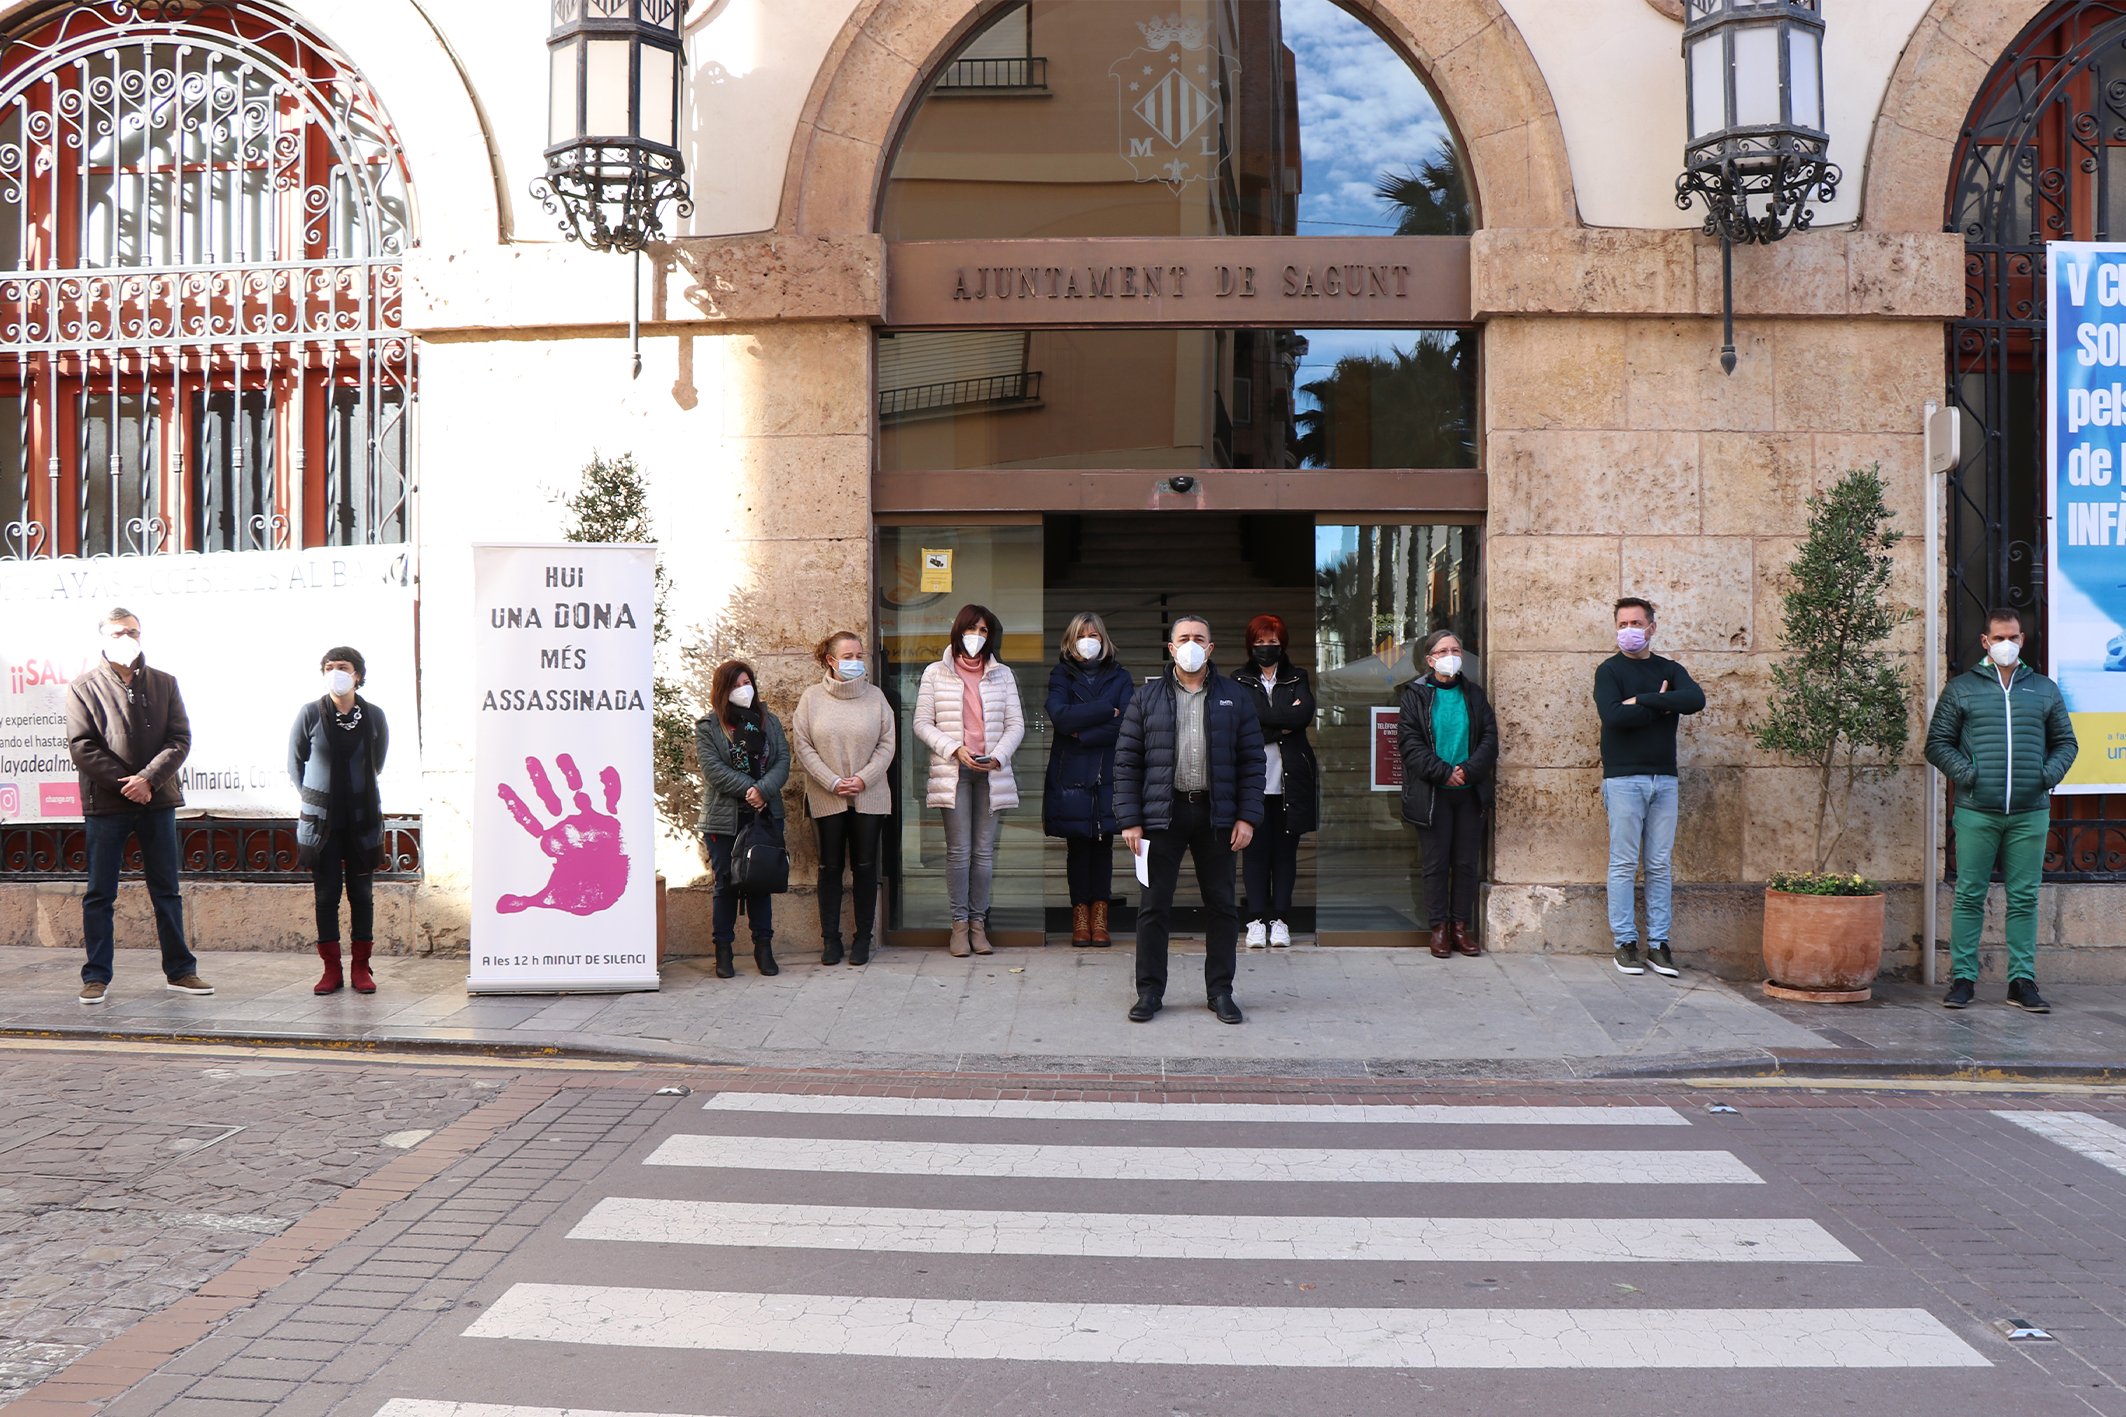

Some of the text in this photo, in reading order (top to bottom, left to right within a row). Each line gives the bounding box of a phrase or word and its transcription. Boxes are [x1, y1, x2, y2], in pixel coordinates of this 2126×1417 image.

[1129, 136, 1220, 158] M L
[953, 264, 1411, 300] AJUNTAMENT DE SAGUNT
[2067, 263, 2089, 306] V
[2077, 322, 2126, 367] SO
[2068, 382, 2126, 433] pel
[2068, 442, 2112, 486] de
[546, 566, 583, 588] HUI
[491, 602, 637, 629] UNA DONA
[541, 645, 586, 670] MÉS
[482, 689, 645, 711] ASSASSINADA
[5, 712, 67, 728] experiencias
[24, 735, 33, 748] el
[181, 765, 244, 792] Almardà,
[45, 795, 75, 804] change.org
[482, 954, 646, 966] A les 12 h MINUT DE SILENCI
